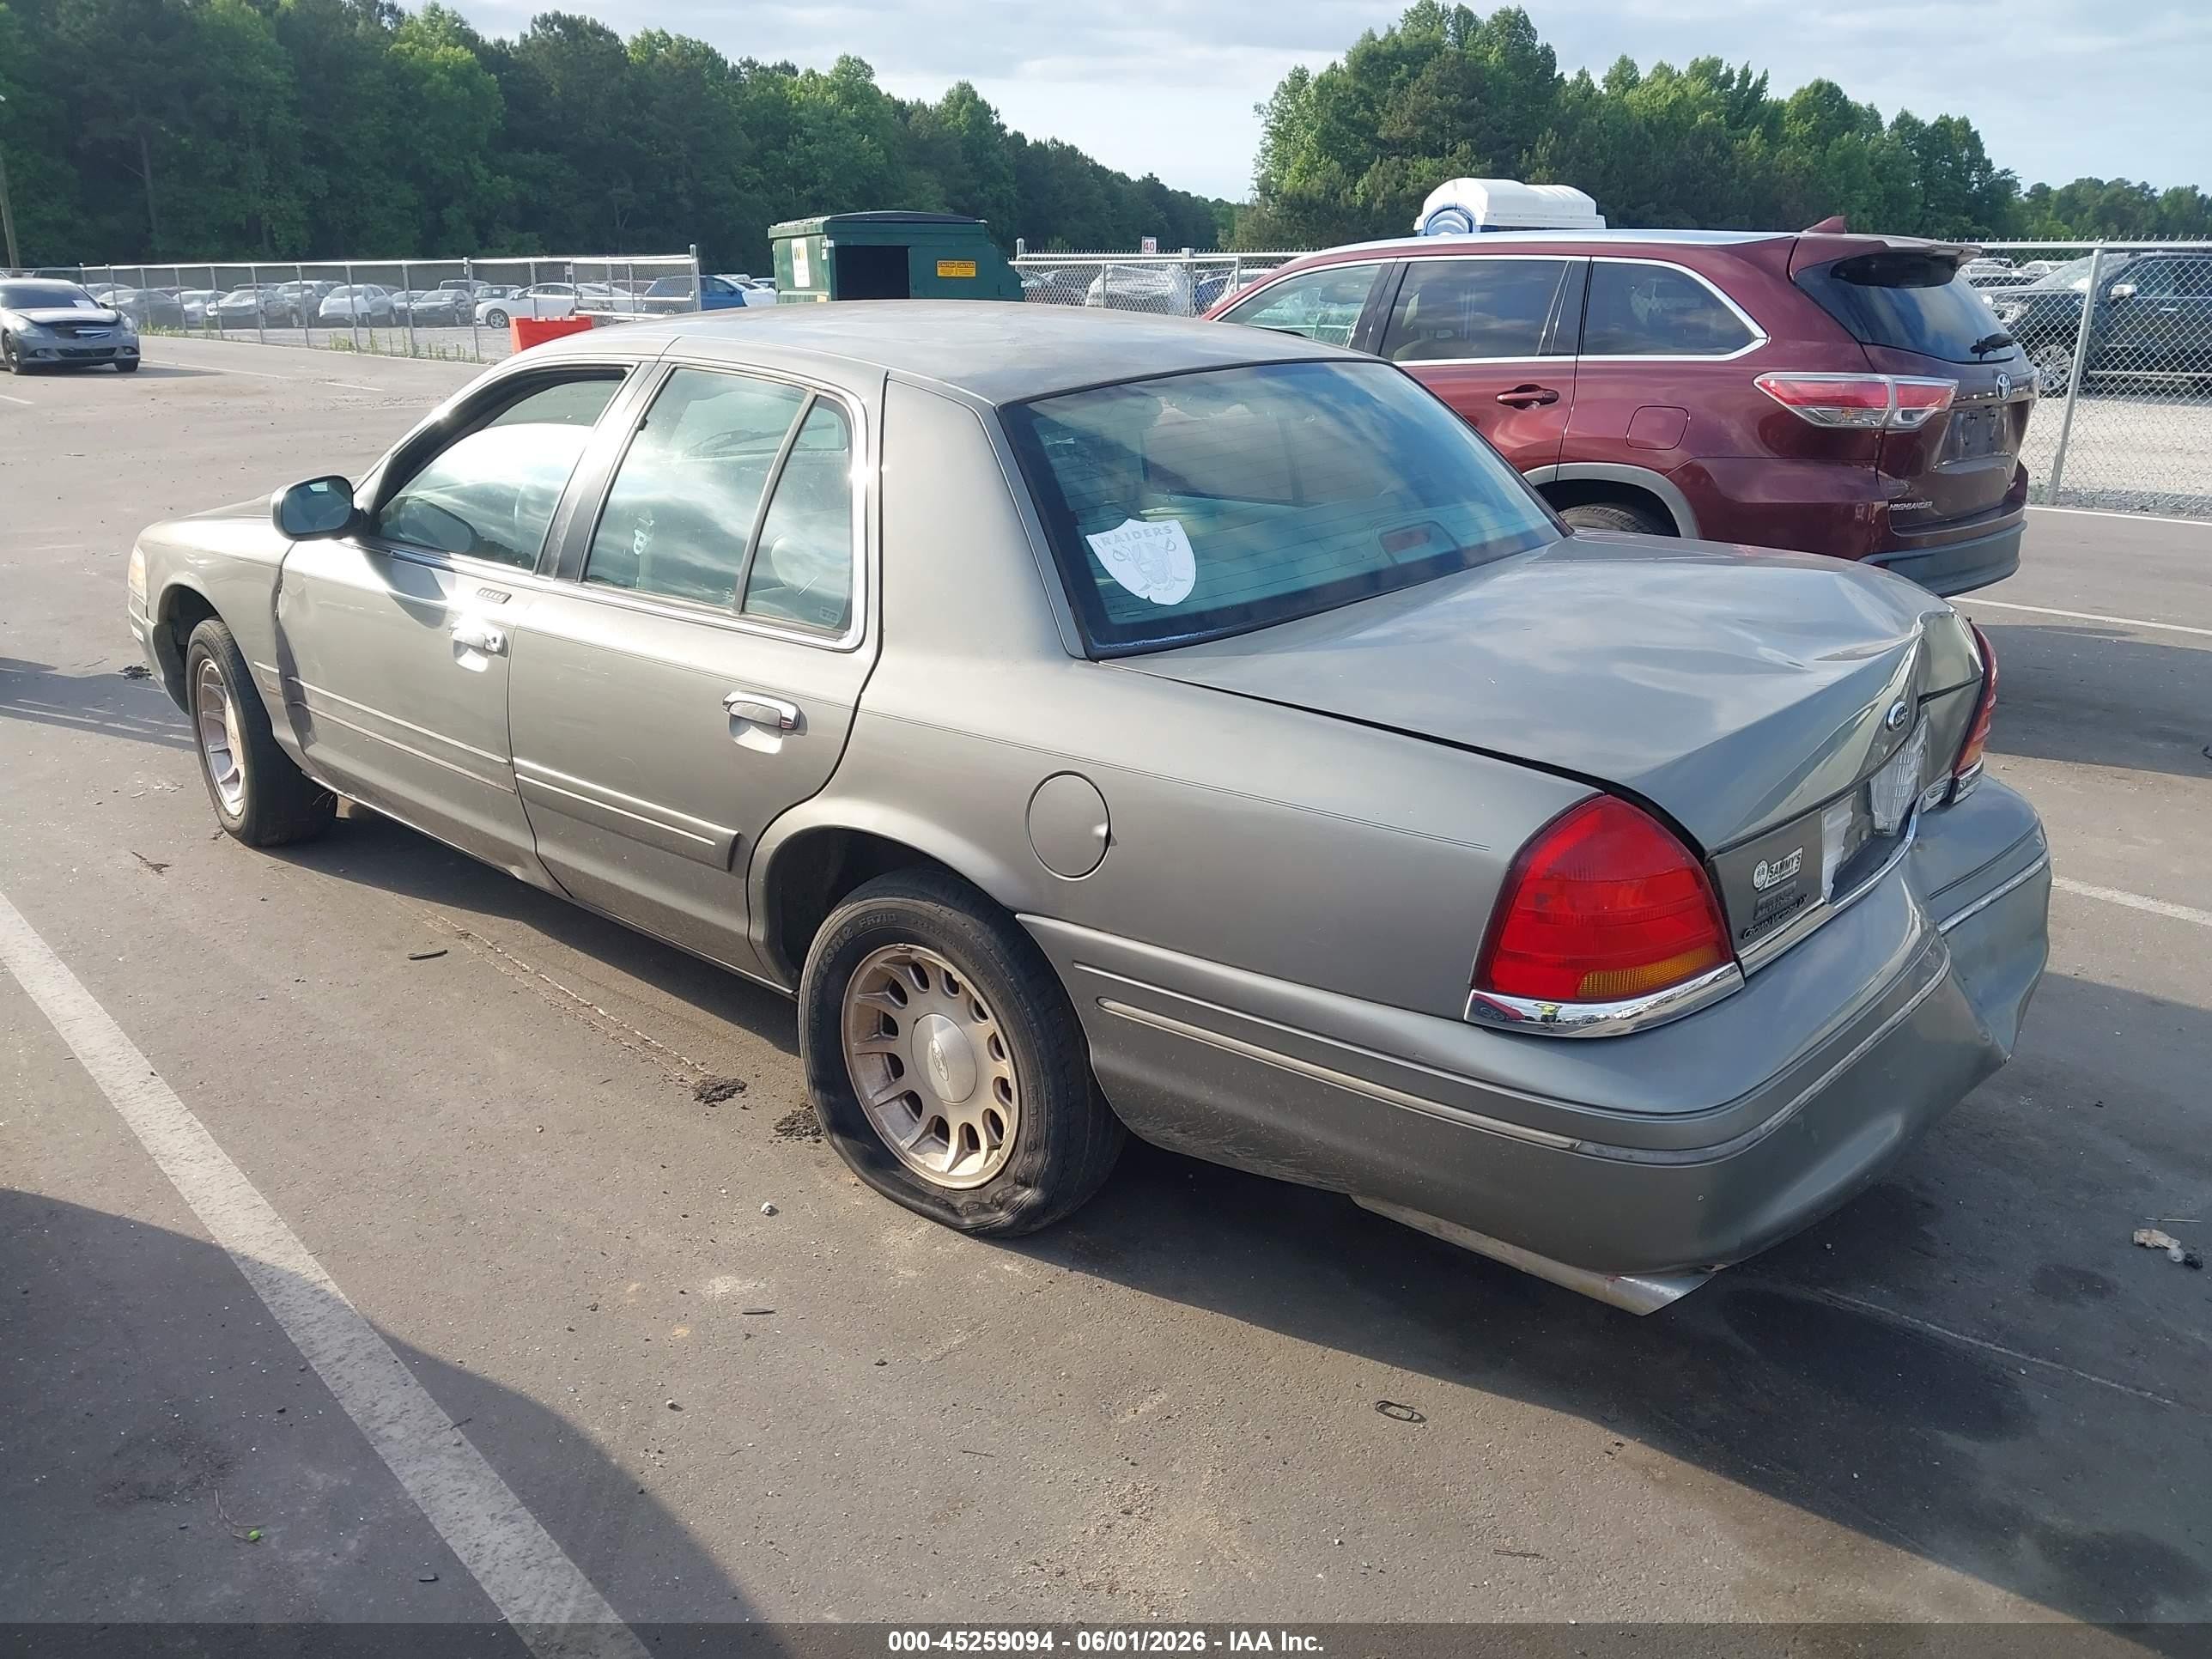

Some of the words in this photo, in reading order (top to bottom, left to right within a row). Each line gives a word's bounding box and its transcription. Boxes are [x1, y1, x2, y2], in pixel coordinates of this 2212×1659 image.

[1889, 501, 1933, 511] HIGHLANDER
[1099, 525, 1173, 548] RAIDERS
[1769, 853, 1802, 878] SAMMY'S
